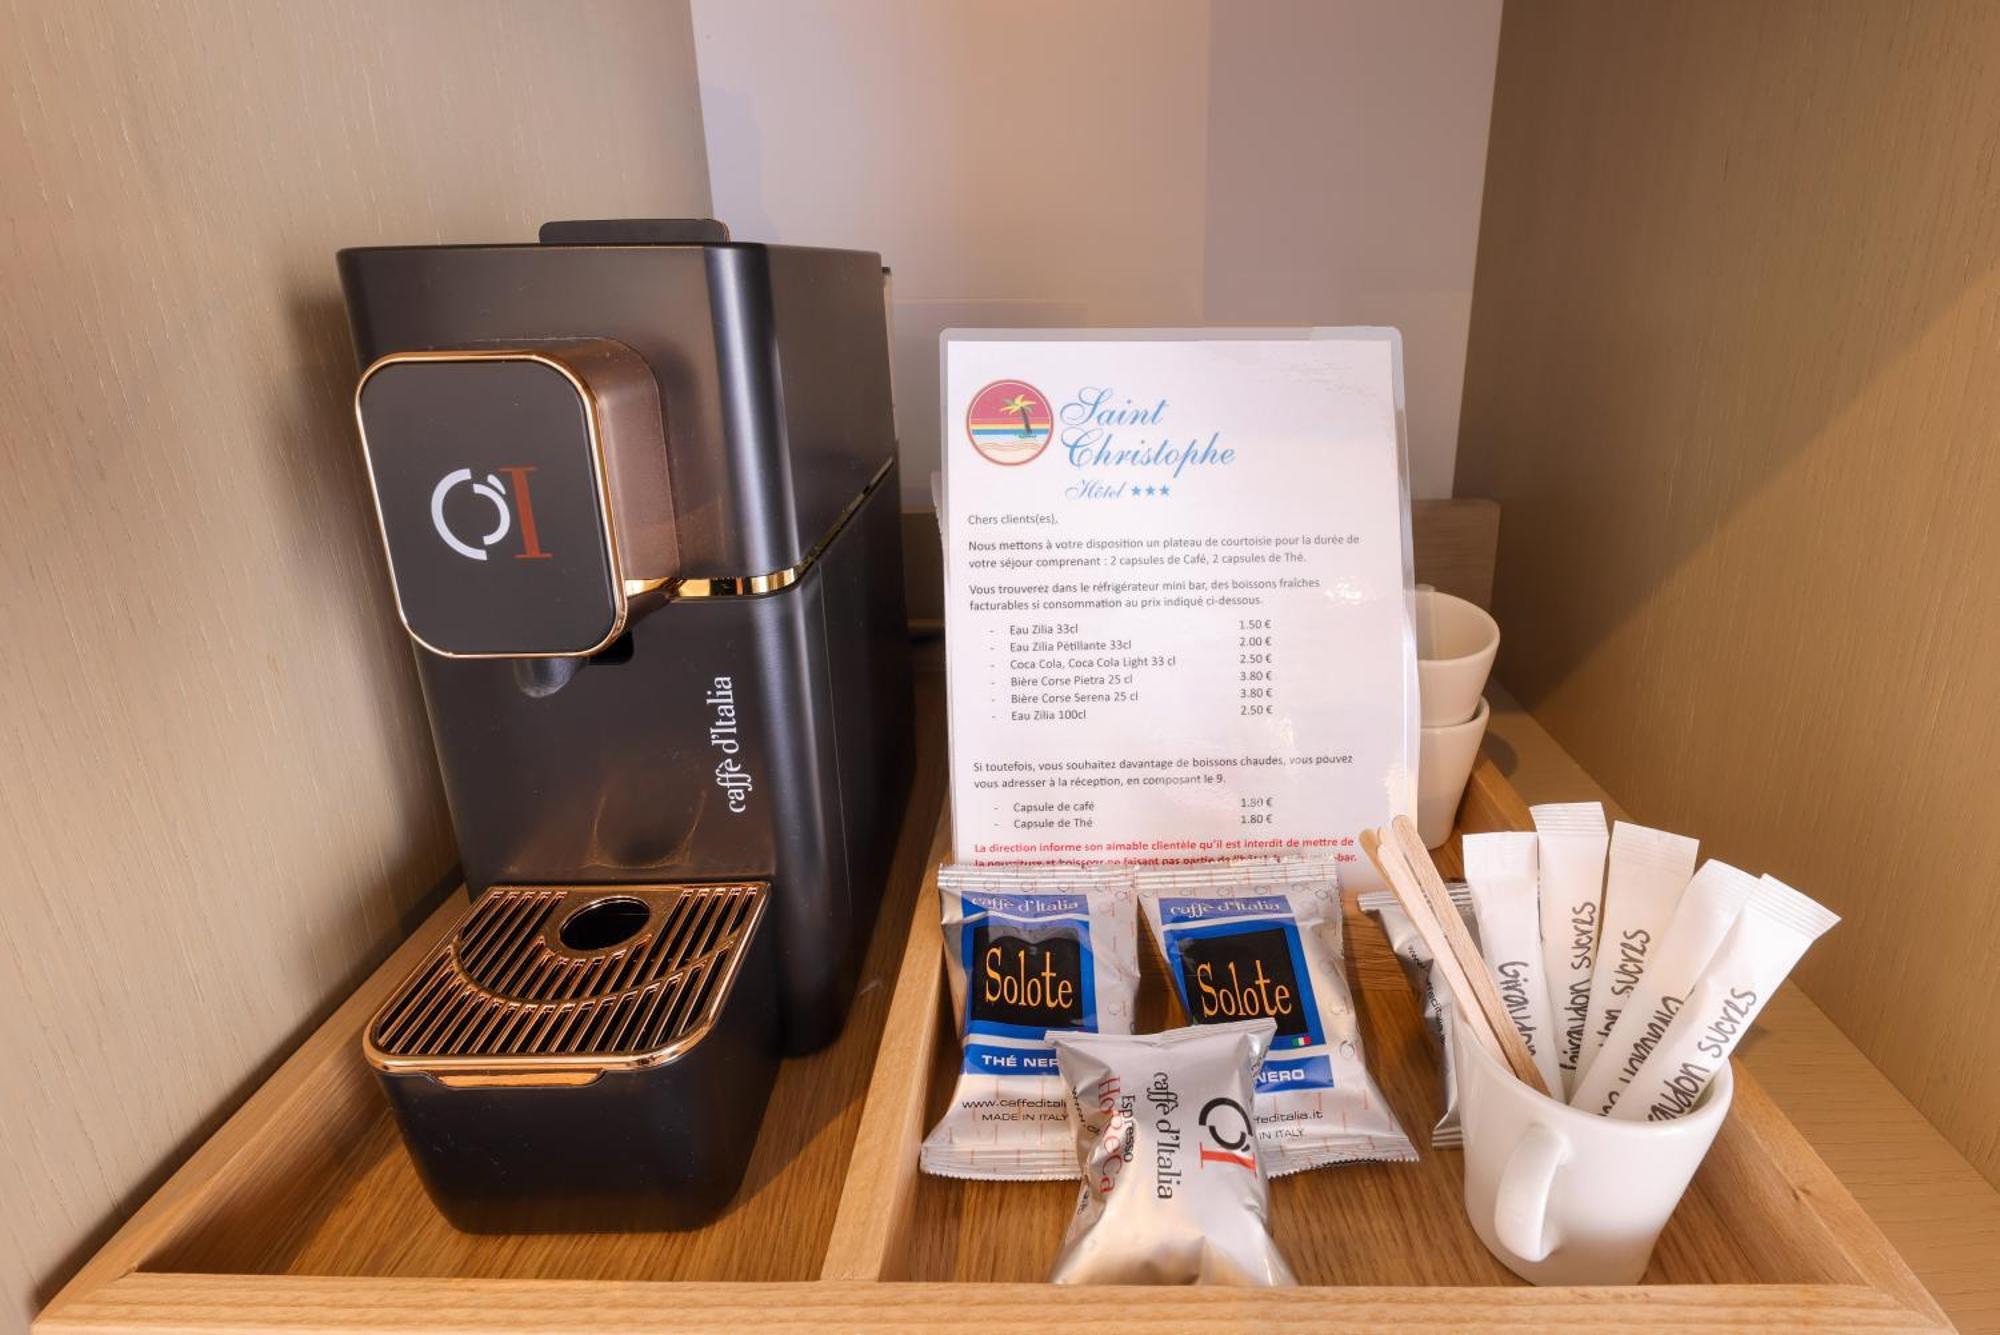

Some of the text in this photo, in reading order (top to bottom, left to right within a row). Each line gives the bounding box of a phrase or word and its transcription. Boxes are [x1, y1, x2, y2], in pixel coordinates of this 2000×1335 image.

[1060, 387, 1167, 426] Saint
[1061, 427, 1236, 478] Christophe
[1065, 480, 1127, 500] Hôtel
[969, 515, 998, 525] Chers
[969, 534, 1359, 553] Nous mettons à votre disposition un plateau de courtoisie pour la durée de
[969, 553, 1306, 570] votre séjour comprenant 2 capsules de Café, 2 capsules de Thé.
[969, 584, 995, 594] Vous
[999, 584, 1049, 594] trouverez
[1052, 583, 1077, 593] dans
[1081, 583, 1090, 592] le
[1093, 582, 1158, 595] réfrigérateur
[1163, 580, 1185, 590] mini
[1189, 580, 1208, 591] bar,
[1211, 580, 1229, 589] des
[1232, 579, 1277, 589] boissons
[970, 600, 1028, 610] facturables
[1032, 600, 1040, 609] si
[1043, 598, 1122, 608] consommation
[1125, 599, 1137, 607] au
[1140, 598, 1160, 611] prix
[1164, 596, 1203, 607] indiqué
[1010, 624, 1078, 634] Eau Zilia 33cl
[1240, 620, 1271, 630] 1.50 €
[1010, 640, 1131, 652] Eau Zilia Pétillante 33cl
[1240, 636, 1272, 646] 2.00 €
[1010, 656, 1176, 670] Coca Cola, Coca Cola Light 33 cl
[1240, 654, 1272, 664] 2.50 €
[1011, 675, 1132, 686] Bière Corse Pietra 25 cl
[1240, 671, 1272, 681] 3.80 €
[1012, 692, 1138, 704] Bière Corse Serena 25 cl
[1240, 688, 1272, 698] 3.80 €
[1012, 710, 1086, 720] Eau Zilia 100cl
[1241, 705, 1273, 715] 2.50 €
[706, 676, 752, 813] caffè d'Italia
[973, 755, 1352, 772] Si toutefois, vous souhaitez davantage de boissons chaudes, vous pouvez
[974, 774, 1226, 789] vous adresser à la réception, en composant le 9.
[1014, 801, 1095, 813] Capsule de café
[1266, 798, 1273, 807] €
[1014, 817, 1092, 829] Capsule de Thé
[1241, 814, 1273, 824] 1.80 €
[975, 836, 1354, 852] La direction informe son aimable clientèle qu'il est interdit de mettre de
[985, 946, 1074, 1009] Solote
[1197, 960, 1292, 1018] Solote
[982, 1055, 1017, 1067] THÉ
[962, 1098, 1066, 1109] www.caffeditali
[981, 1113, 1018, 1121] MADE
[1040, 1113, 1068, 1121] ITALY
[1118, 1095, 1136, 1163] Espresso
[1275, 1128, 1304, 1140] ITALY
[1146, 1072, 1182, 1199] caffè d'Italia
